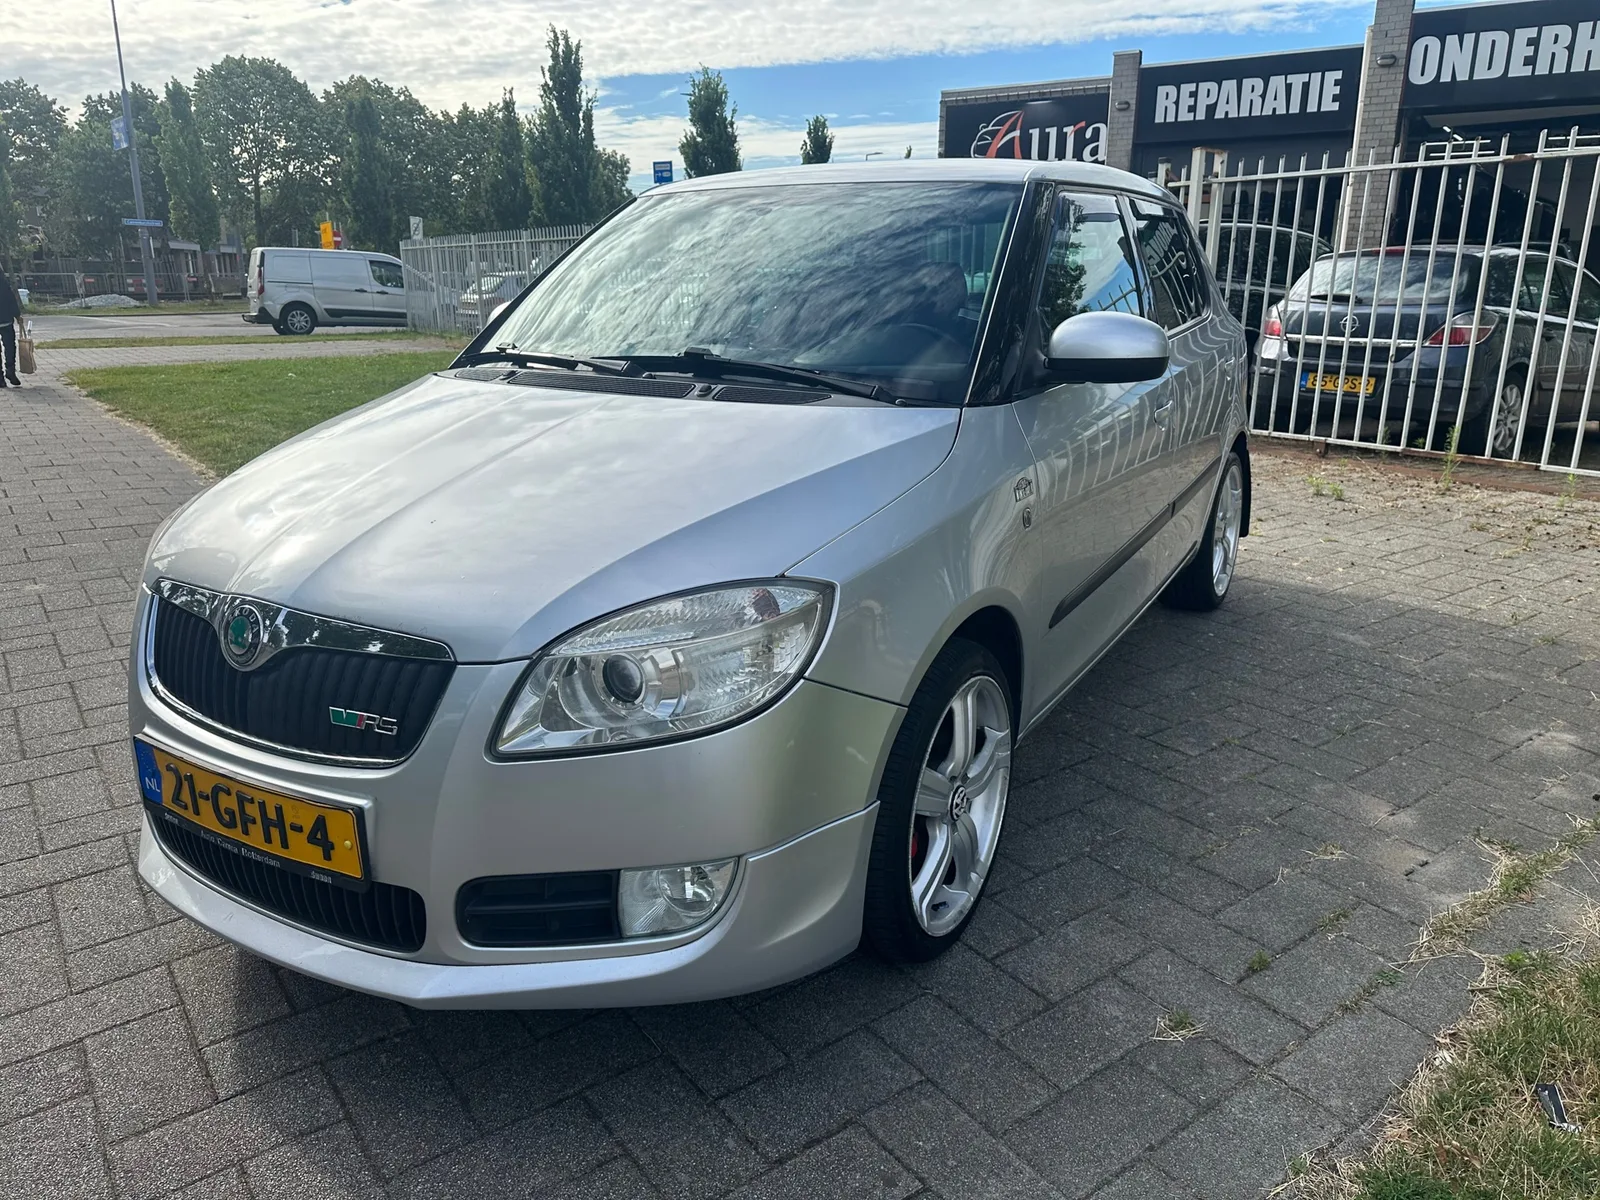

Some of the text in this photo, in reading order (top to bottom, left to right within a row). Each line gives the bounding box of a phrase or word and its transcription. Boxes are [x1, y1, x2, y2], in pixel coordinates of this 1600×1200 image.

[1408, 20, 1600, 85] ONDERH
[1154, 69, 1343, 123] REPARATIE
[985, 110, 1107, 162] Aura
[145, 776, 161, 793] NL
[166, 763, 335, 862] 21-GFH-4
